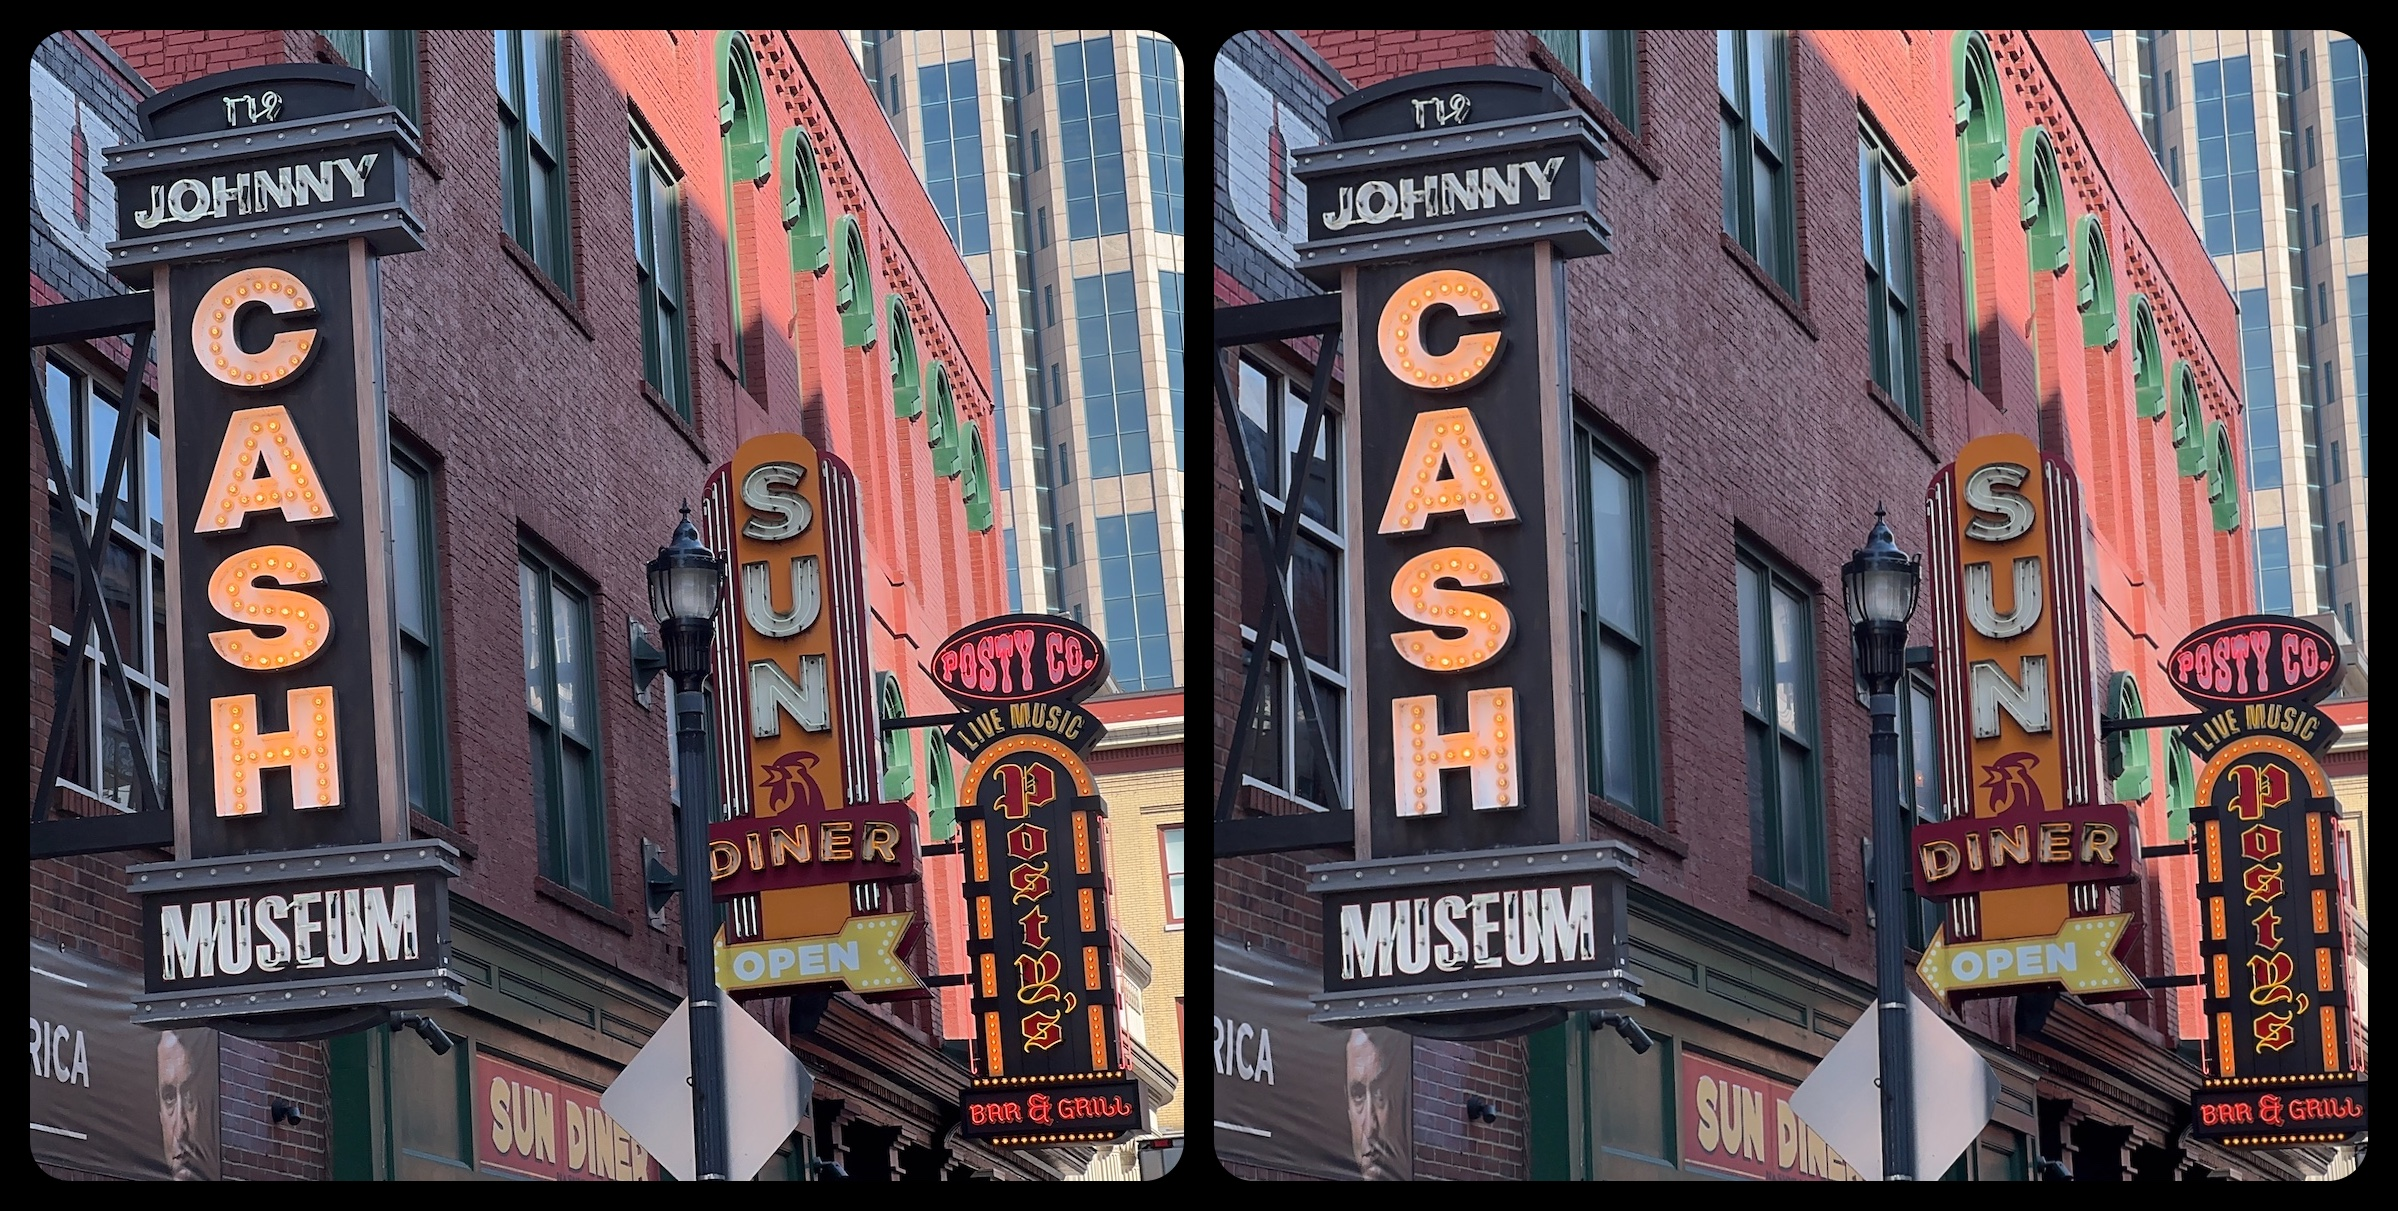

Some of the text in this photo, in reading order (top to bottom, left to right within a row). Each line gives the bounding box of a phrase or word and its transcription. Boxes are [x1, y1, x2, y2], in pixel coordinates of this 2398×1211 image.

[134, 153, 378, 229] JOHNNY
[1322, 156, 1565, 231] JOHNNY
[192, 267, 340, 818] CASH
[1377, 269, 1520, 818] CASH
[741, 462, 833, 739] SUN
[1963, 462, 2053, 740] SUN
[941, 629, 1093, 694] POSTY CO.
[2177, 630, 2330, 695] POSTY CO.
[956, 702, 1086, 751] LIVE MUSIC
[2192, 703, 2321, 752] LIVE MUSIC
[710, 820, 901, 882] DINER
[1919, 822, 2119, 883] DINER
[160, 883, 419, 981] MUSEUM
[733, 940, 860, 982] OPEN
[1340, 884, 1596, 980] MUSEUM
[1951, 941, 2077, 982] OPEN
[30, 1016, 90, 1088] RICA
[490, 1076, 556, 1164] SUN
[969, 1092, 1133, 1126] BAR & GRILL
[1696, 1075, 1867, 1181] SUN DIN
[2200, 1093, 2364, 1127] BAR & GRILL
